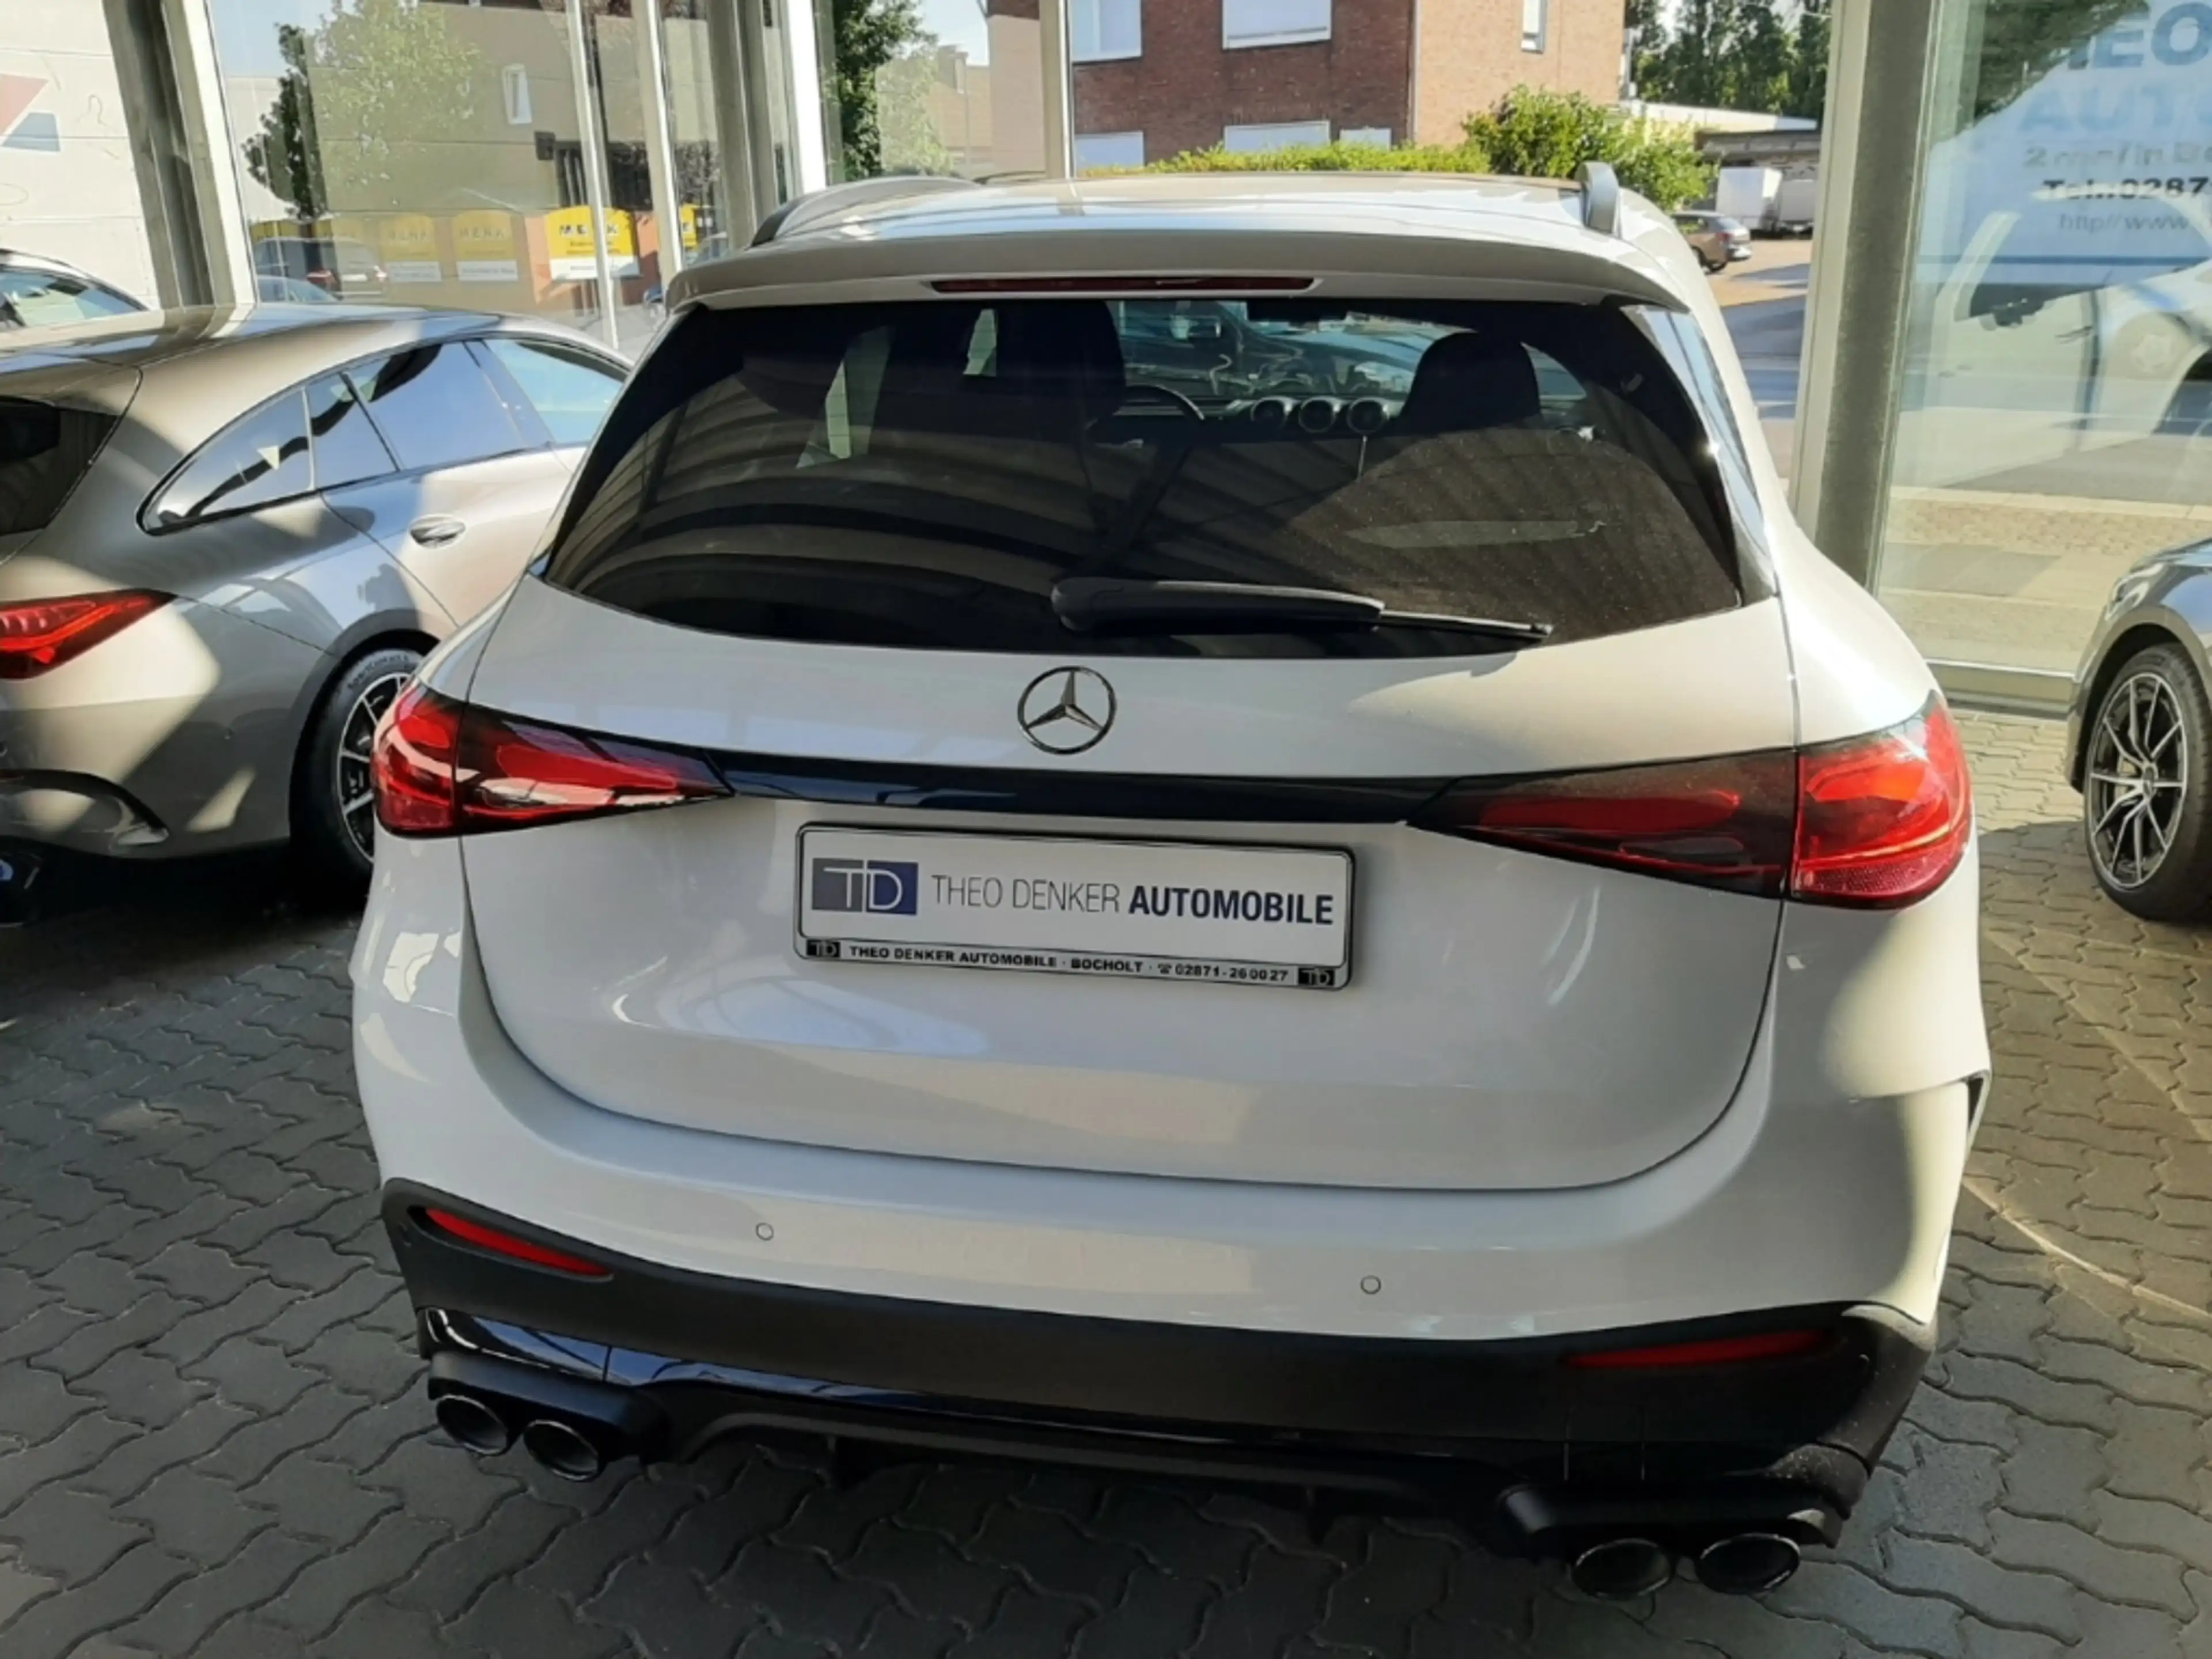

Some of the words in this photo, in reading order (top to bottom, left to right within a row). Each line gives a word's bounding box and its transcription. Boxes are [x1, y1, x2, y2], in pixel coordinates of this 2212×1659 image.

[823, 866, 904, 911] TD
[931, 874, 1003, 908] THEO
[1012, 879, 1120, 914] DENKER
[1128, 884, 1334, 926] AUTOMOBILE
[849, 945, 889, 959] THEO
[894, 947, 955, 963] DENKER
[959, 951, 1057, 968] AUTOMOBILE
[1070, 957, 1143, 973] BOCHOLT
